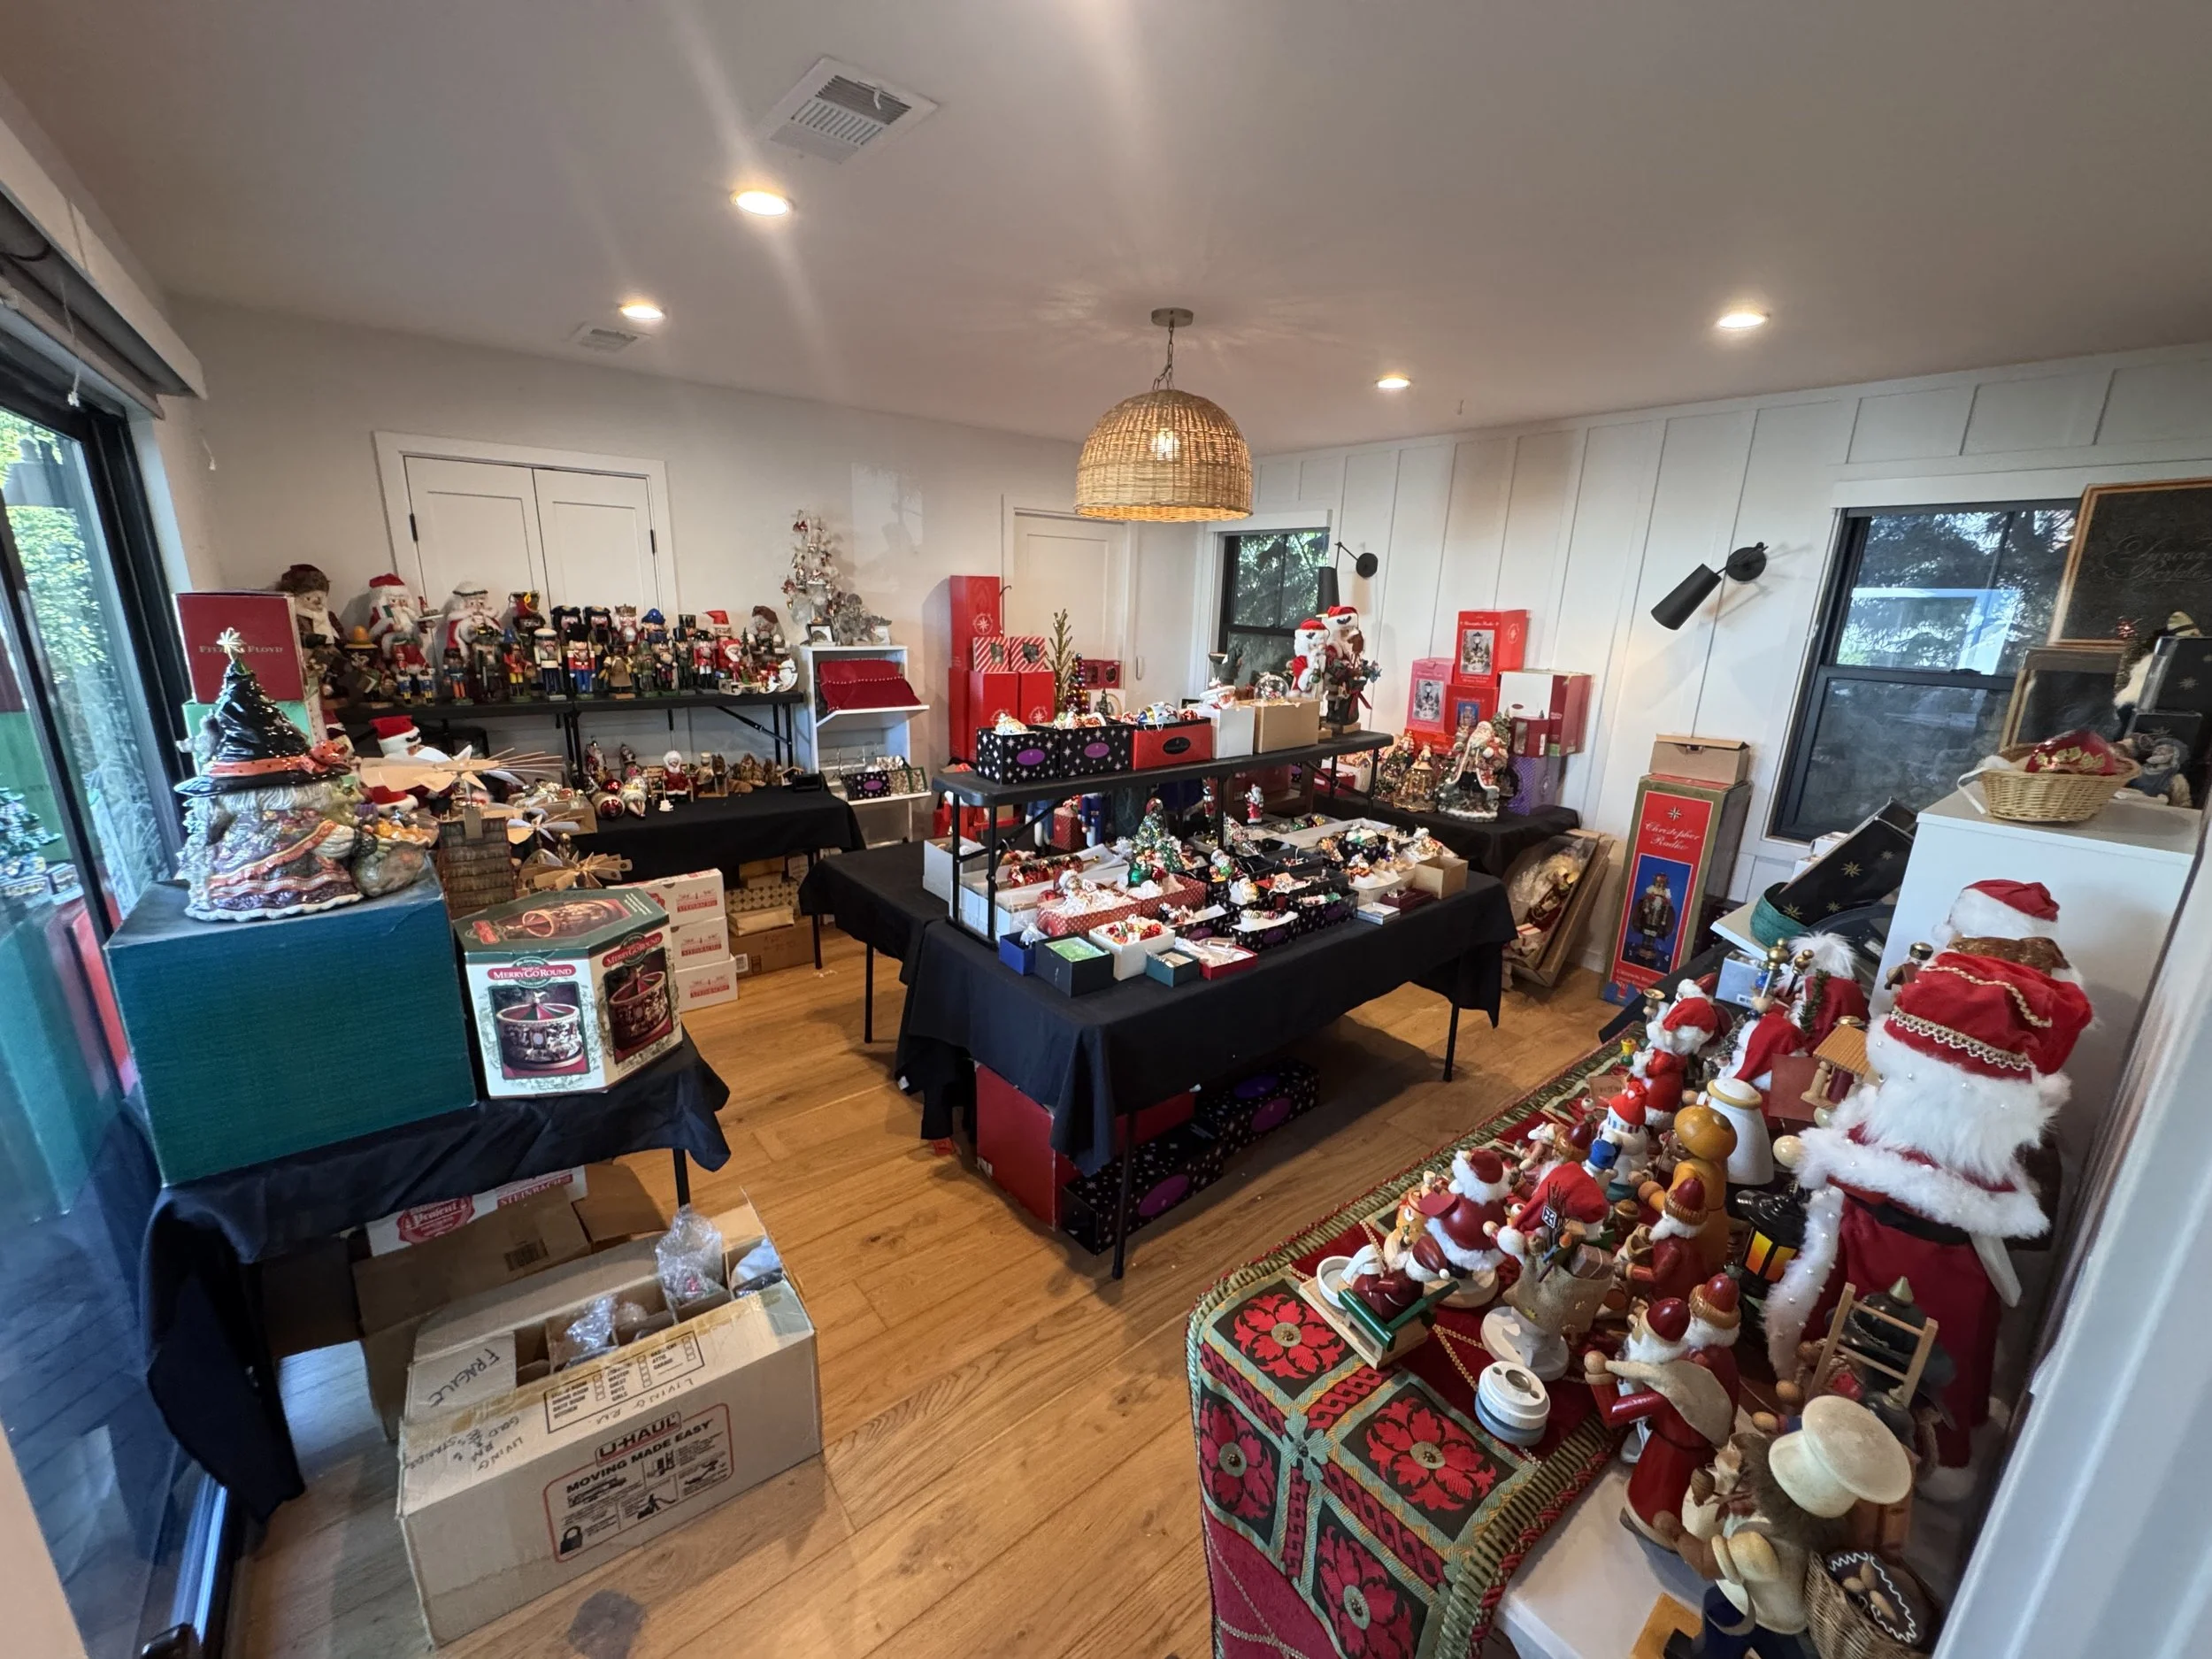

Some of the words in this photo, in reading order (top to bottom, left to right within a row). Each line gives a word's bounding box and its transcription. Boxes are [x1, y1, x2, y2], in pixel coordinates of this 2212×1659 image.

[428, 1348, 501, 1409] FRAGILE
[565, 1459, 628, 1494] MOVING
[630, 1435, 672, 1463] MADE
[675, 1417, 714, 1443] EASY
